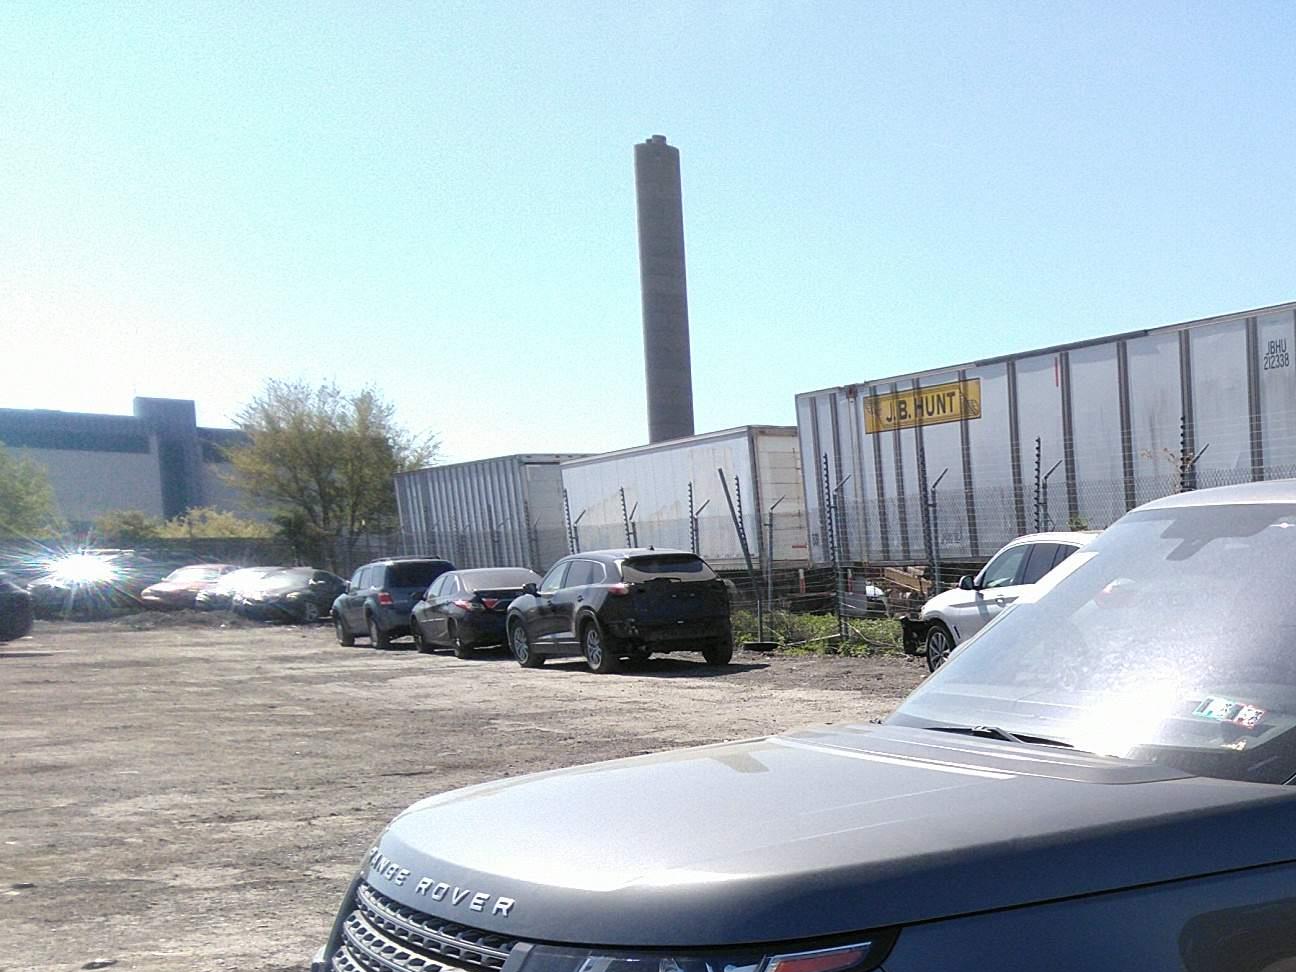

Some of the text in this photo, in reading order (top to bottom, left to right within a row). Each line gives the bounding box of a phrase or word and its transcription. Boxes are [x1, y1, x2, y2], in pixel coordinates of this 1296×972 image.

[1265, 339, 1287, 356] JBHU
[1263, 353, 1290, 370] 212338
[886, 391, 956, 422] J.B. HUNT
[415, 876, 517, 917] ROVER
